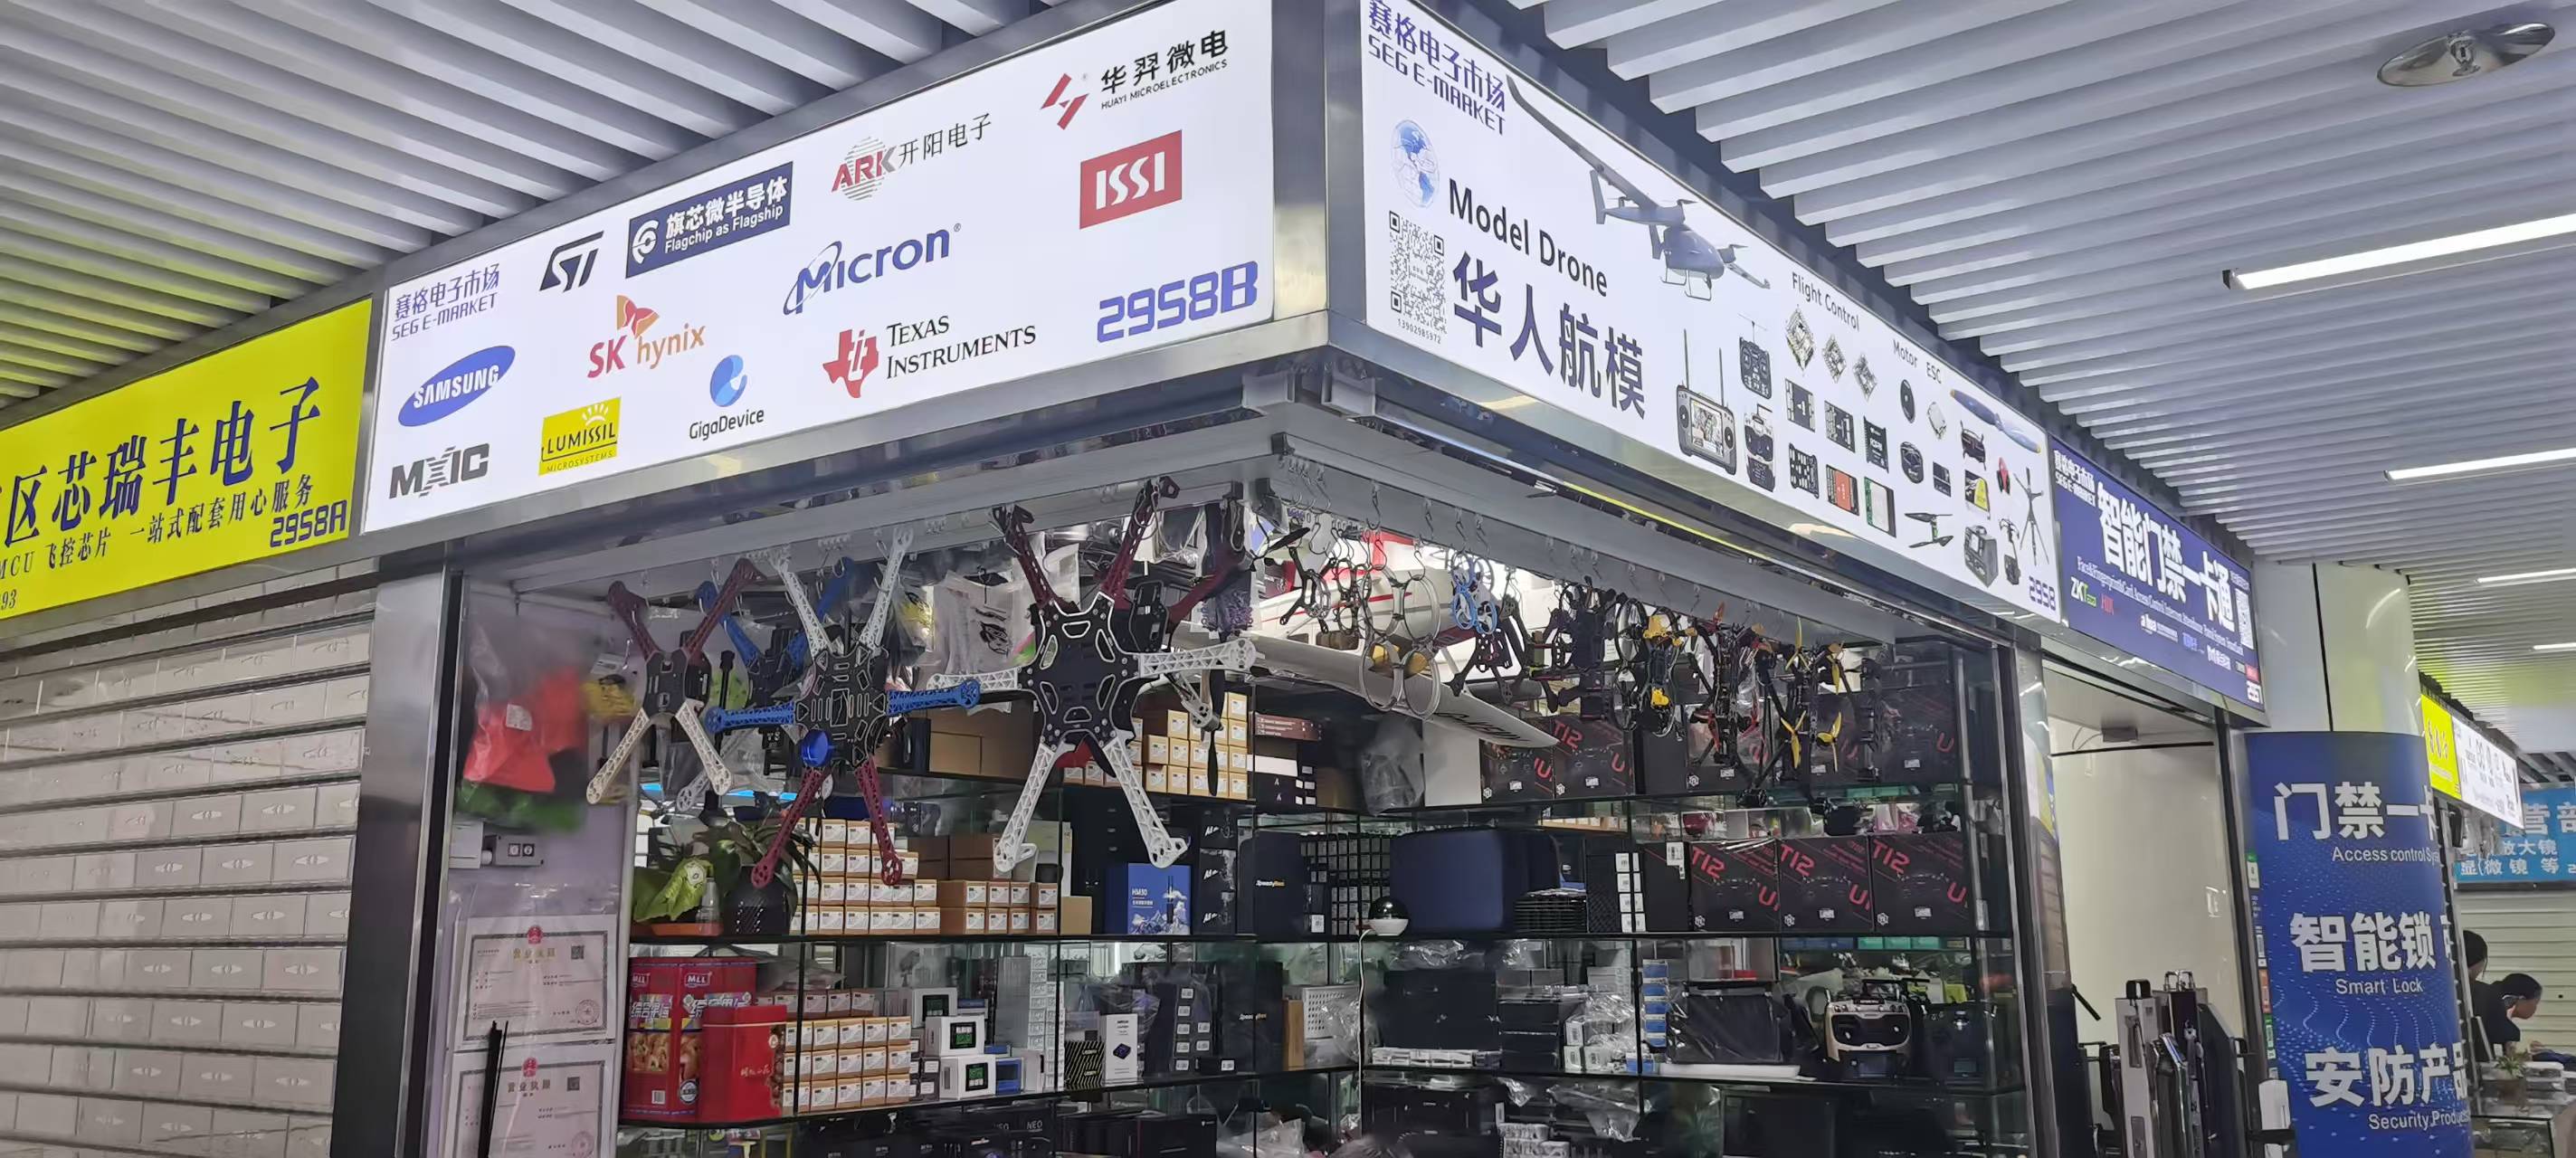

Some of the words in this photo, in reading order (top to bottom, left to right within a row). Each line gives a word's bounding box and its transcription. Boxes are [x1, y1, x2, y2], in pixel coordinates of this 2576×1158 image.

[1100, 29, 1229, 95] 华羿微电
[1368, 0, 1506, 112] 赛格电子市场
[1100, 94, 1127, 110] HUAYI
[1129, 59, 1229, 100] MICROELECTRONICS
[1368, 33, 1408, 76] SEG
[1413, 62, 1506, 136] E-MARKET
[898, 112, 993, 169] 开阳电子
[665, 176, 788, 239] 旗芯微半导体
[1095, 150, 1165, 210] ISSI
[664, 228, 713, 254] Flagchip
[716, 223, 729, 236] as
[732, 204, 784, 232] Flagship
[1449, 178, 1529, 255] Model
[1539, 232, 1608, 298] Drone
[391, 318, 419, 341] SEG
[423, 292, 499, 331] E-MARKET
[394, 262, 500, 322] 赛格电子市场
[1792, 271, 1822, 306] Flight
[1825, 294, 1860, 332] Control
[587, 335, 627, 379] SK
[636, 322, 707, 370] hynix
[886, 315, 950, 348] TEXAS
[886, 325, 1037, 380] INSTRUMENTS
[1452, 251, 1646, 420] 华人航模
[1893, 339, 1918, 368] Motor
[413, 365, 500, 409] SAMSUNG
[1925, 362, 1942, 384] ESC
[547, 422, 617, 455] LUMISSIL
[689, 408, 765, 441] GigaDevice
[5, 376, 321, 548] 区芯瑞丰电子
[546, 450, 614, 472] MICROSYSTEMS
[45, 527, 112, 570] 飞控芯片
[129, 473, 314, 546] 一站式配套用心服务
[2097, 481, 2237, 632] 智能门禁一卡通
[2332, 846, 2389, 862] Access
[2391, 847, 2426, 862] control
[2335, 979, 2385, 995] Smart
[2393, 977, 2424, 993] Lock
[2369, 1114, 2430, 1131] Security
